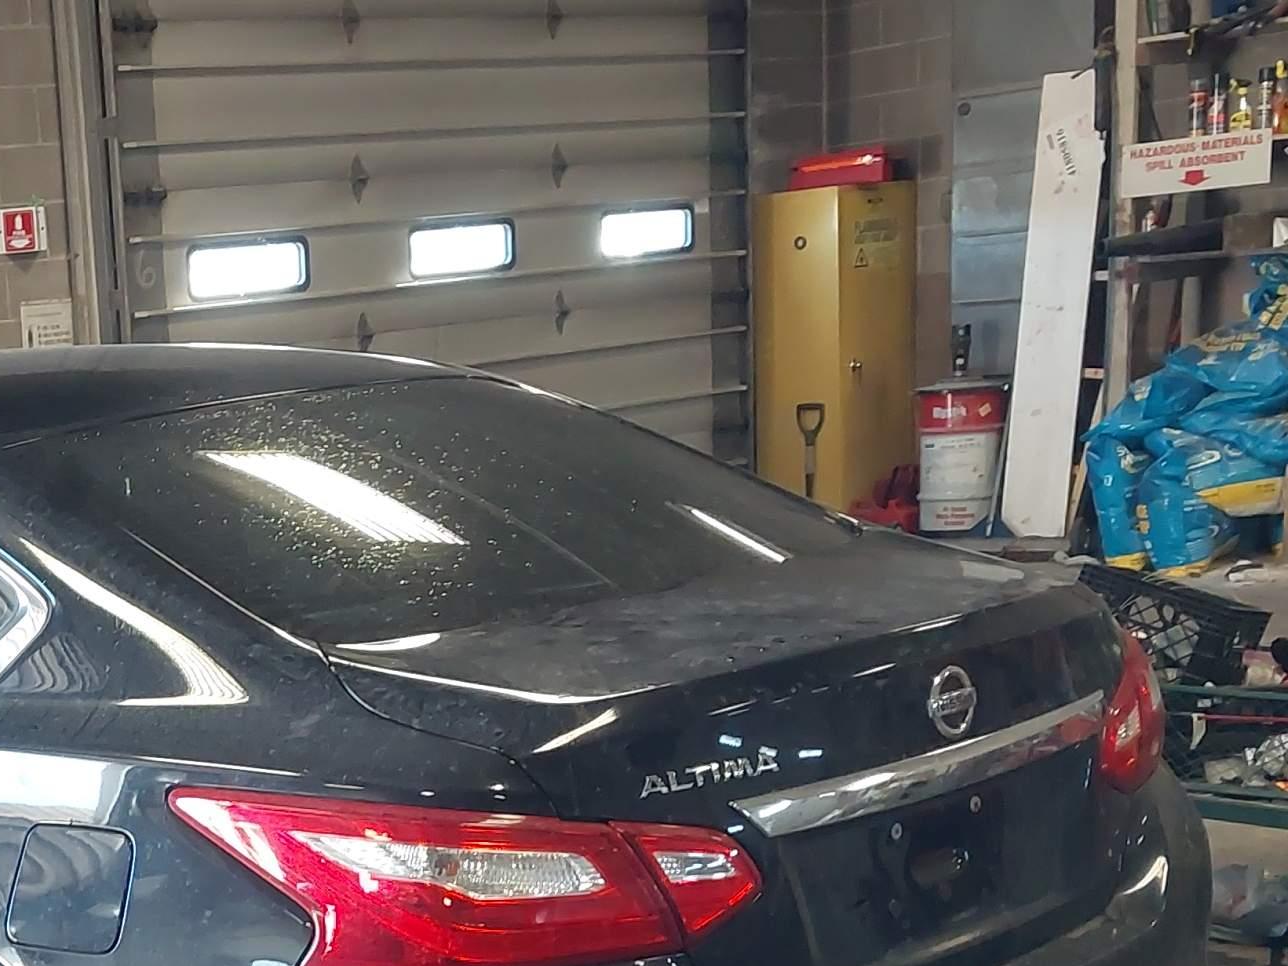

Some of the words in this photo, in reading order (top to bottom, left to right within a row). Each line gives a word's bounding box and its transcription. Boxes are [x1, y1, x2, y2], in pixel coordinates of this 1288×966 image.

[1130, 142, 1197, 160] HAZARDOUS
[1201, 134, 1263, 150] MATERIALS
[1145, 159, 1174, 172] SPILL
[1179, 150, 1246, 169] ABSORBENT
[135, 248, 157, 289] 6
[639, 750, 780, 799] ALTIMA
